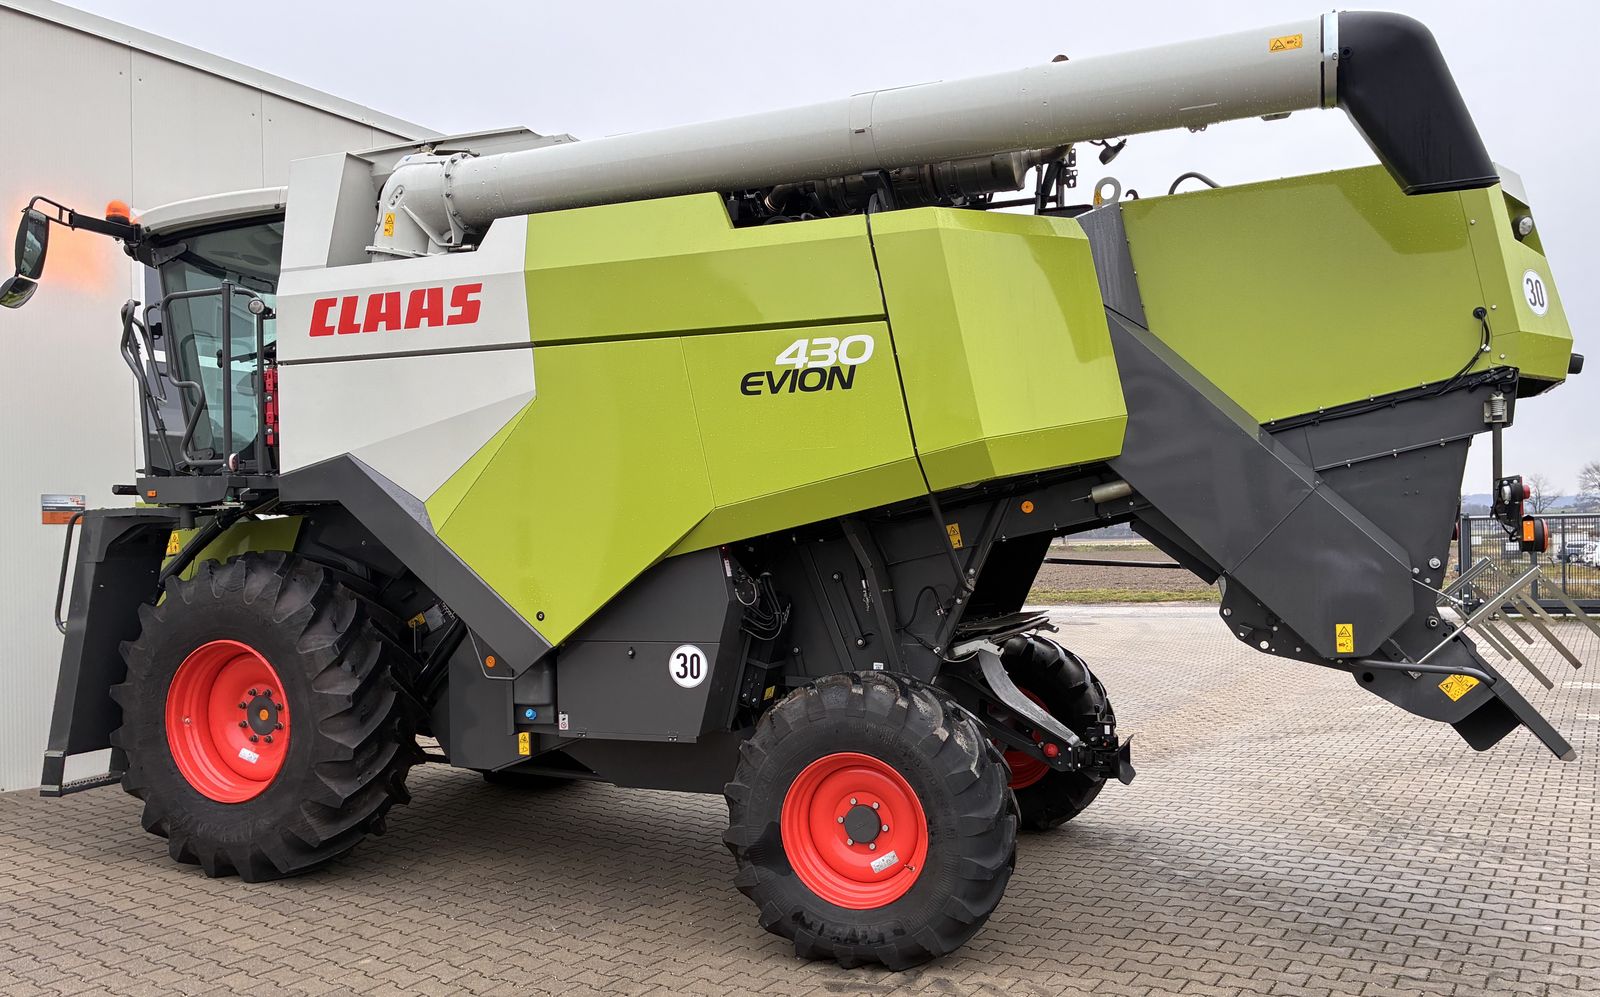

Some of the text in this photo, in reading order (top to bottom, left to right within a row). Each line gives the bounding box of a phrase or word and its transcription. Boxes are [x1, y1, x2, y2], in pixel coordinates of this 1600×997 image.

[1526, 277, 1545, 308] 30
[309, 283, 482, 337] CLAAS
[775, 334, 875, 369] 430
[740, 364, 857, 396] EVION
[675, 652, 701, 680] 30
